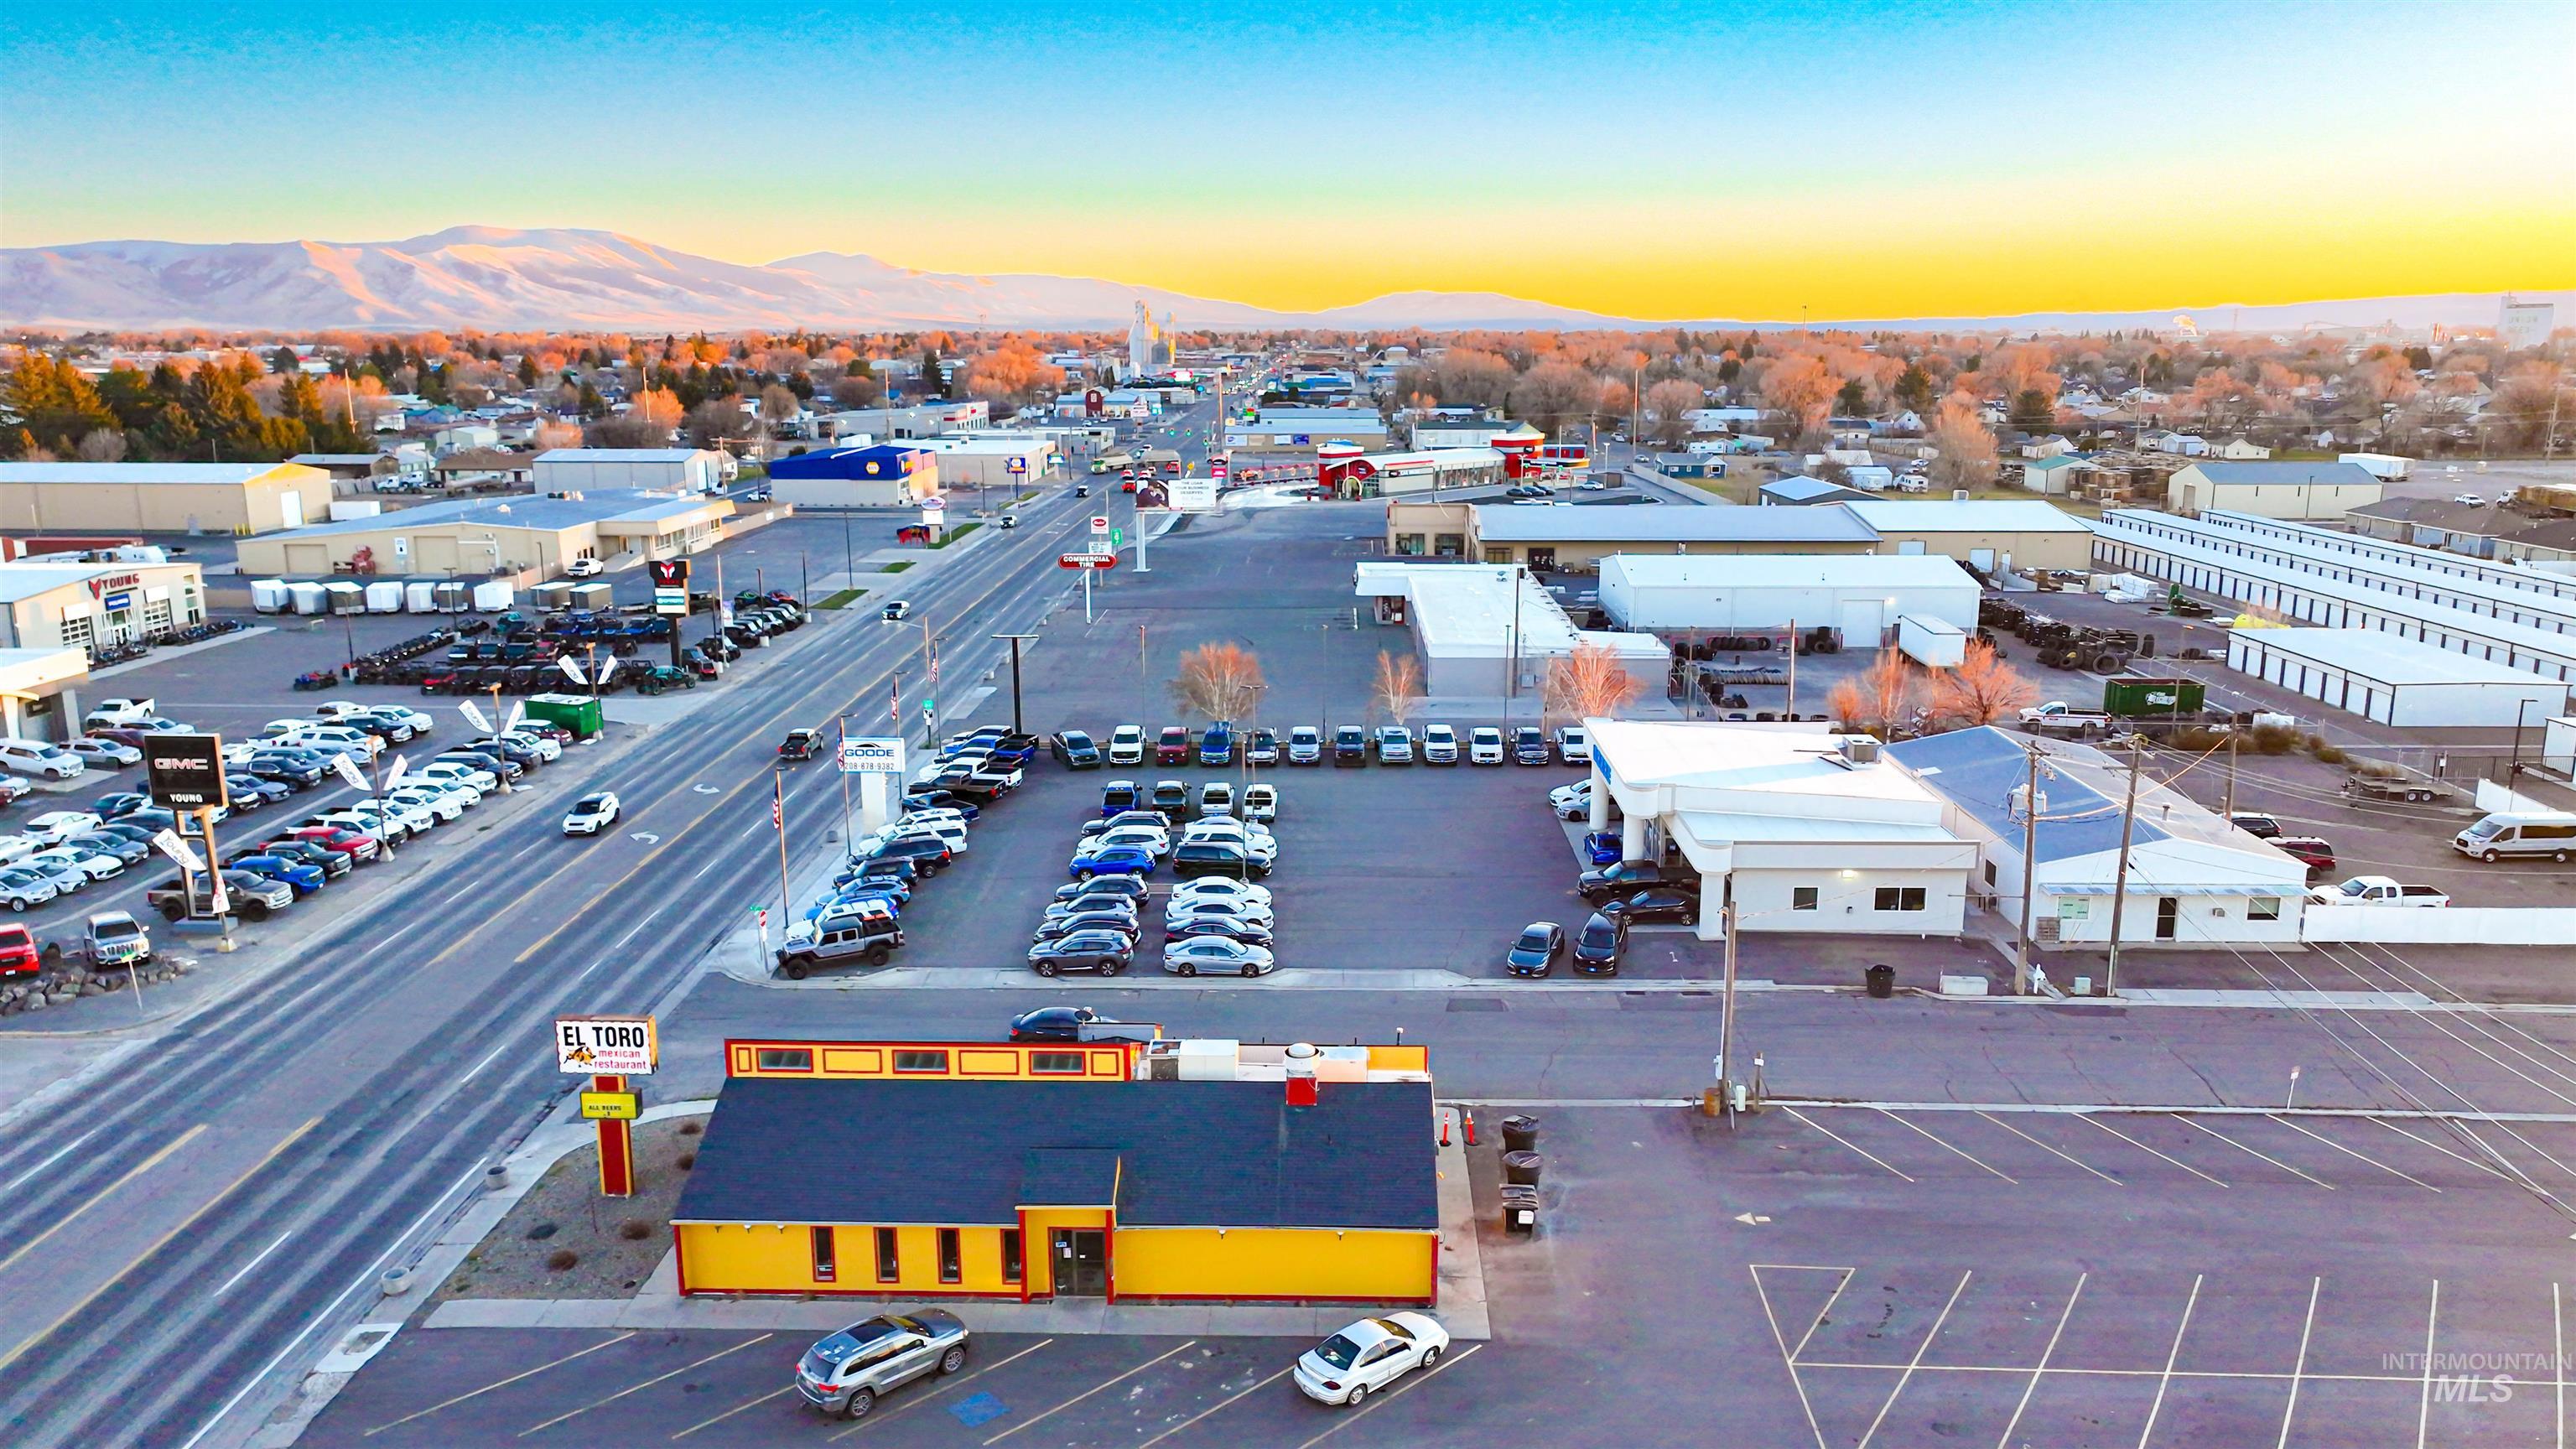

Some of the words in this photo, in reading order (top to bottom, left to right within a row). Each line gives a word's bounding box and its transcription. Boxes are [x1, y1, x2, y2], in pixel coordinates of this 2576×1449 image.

[101, 573, 140, 589] YOUNG
[844, 749, 895, 757] GOODE
[154, 758, 208, 770] GMC
[169, 793, 203, 803] YOUNG
[162, 835, 190, 865] Young
[563, 1026, 586, 1046] EL
[592, 1026, 644, 1048] TORO
[598, 1049, 641, 1058] mexican
[595, 1060, 647, 1069] restaurant
